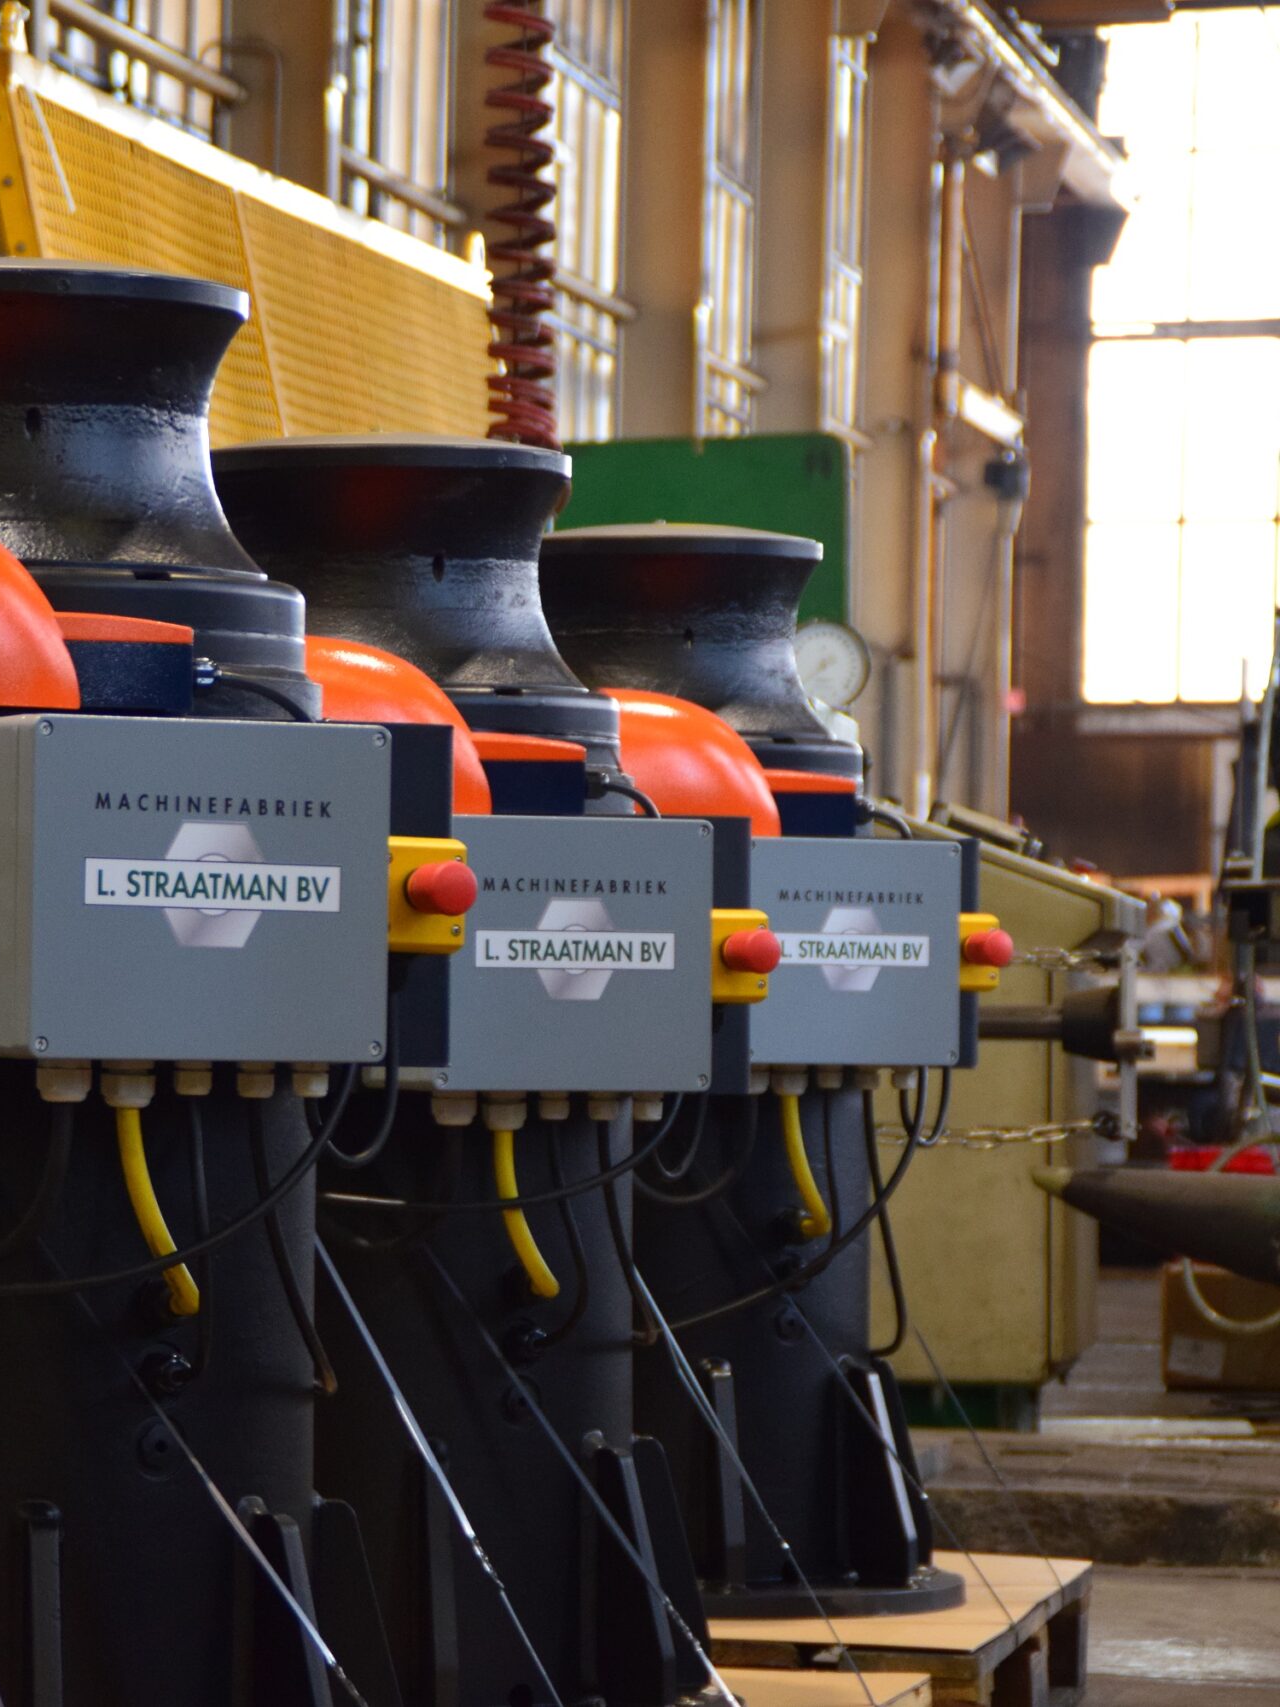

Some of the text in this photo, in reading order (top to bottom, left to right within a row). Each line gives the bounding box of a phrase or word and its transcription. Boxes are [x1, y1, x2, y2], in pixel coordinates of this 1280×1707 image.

[95, 792, 331, 818] MACHINEFABRIEK
[97, 869, 330, 903] L. STRAATMAN BV
[483, 877, 667, 894] MACHINEFABRIEK
[779, 889, 924, 904] MACHINEFABRIEK
[485, 939, 666, 962] L. STRAATMAN BV
[798, 940, 897, 960] STRAATMAN
[902, 943, 923, 961] BV
